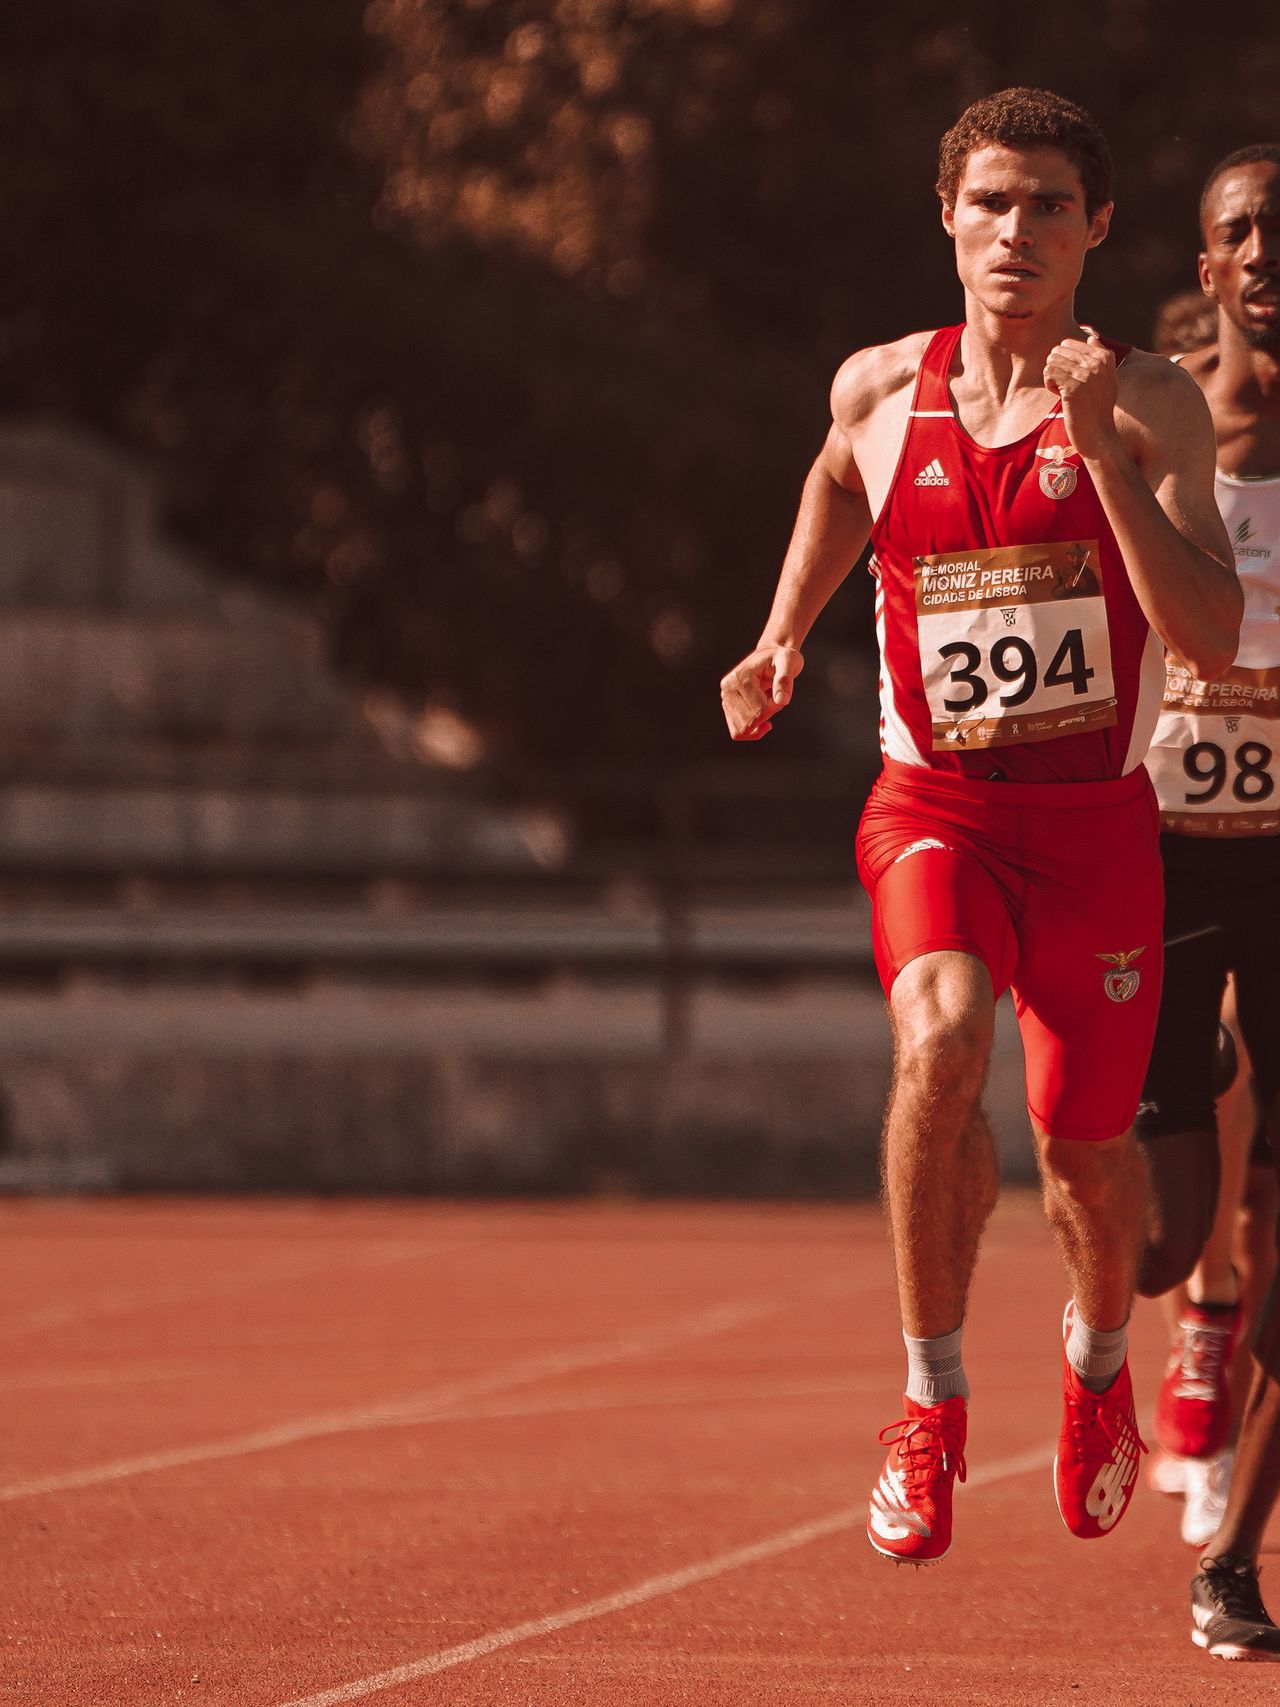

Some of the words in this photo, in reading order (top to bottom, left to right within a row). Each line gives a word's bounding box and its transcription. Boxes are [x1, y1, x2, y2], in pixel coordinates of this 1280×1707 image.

[913, 476, 950, 487] adidas
[921, 560, 981, 577] MEMORIAL
[922, 572, 977, 593] MONIZ
[980, 565, 1054, 587] PEREIRA
[922, 591, 966, 606] CIDADE
[967, 589, 983, 601] DE
[985, 585, 1028, 599] LISBOA
[937, 628, 1095, 713] 394
[1208, 683, 1280, 702] PEREIRA
[1212, 698, 1255, 709] LISBOA
[1182, 741, 1276, 805] 98
